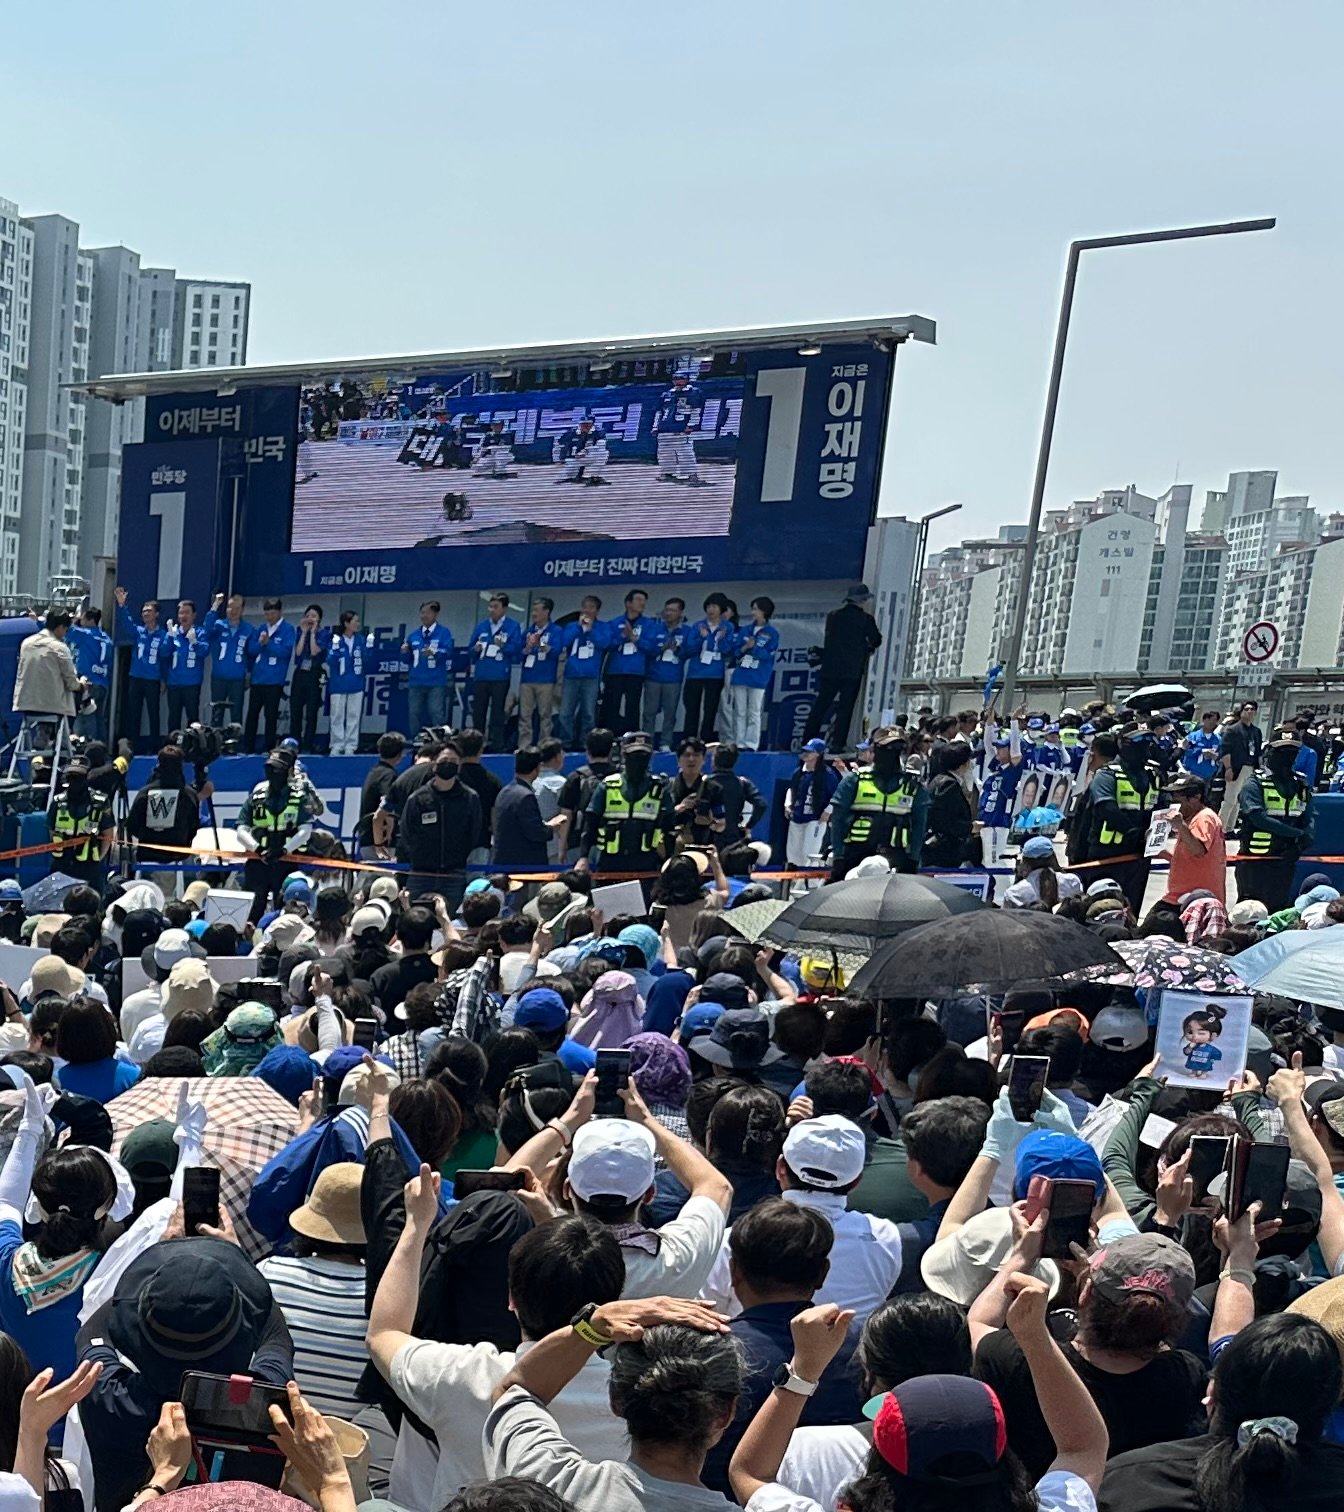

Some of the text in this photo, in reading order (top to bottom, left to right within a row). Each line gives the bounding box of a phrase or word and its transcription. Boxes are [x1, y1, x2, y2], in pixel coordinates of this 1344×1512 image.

[831, 363, 869, 378] 지금은
[159, 405, 241, 435] 이제부터
[755, 366, 807, 502] 1
[819, 380, 866, 499] 이재명
[149, 491, 186, 600] 1
[1107, 530, 1131, 541] 건영
[304, 560, 313, 586] 1
[344, 565, 397, 584] 이재명
[544, 554, 703, 577] 이제부터 진짜 대한민국
[1106, 565, 1121, 575] 111
